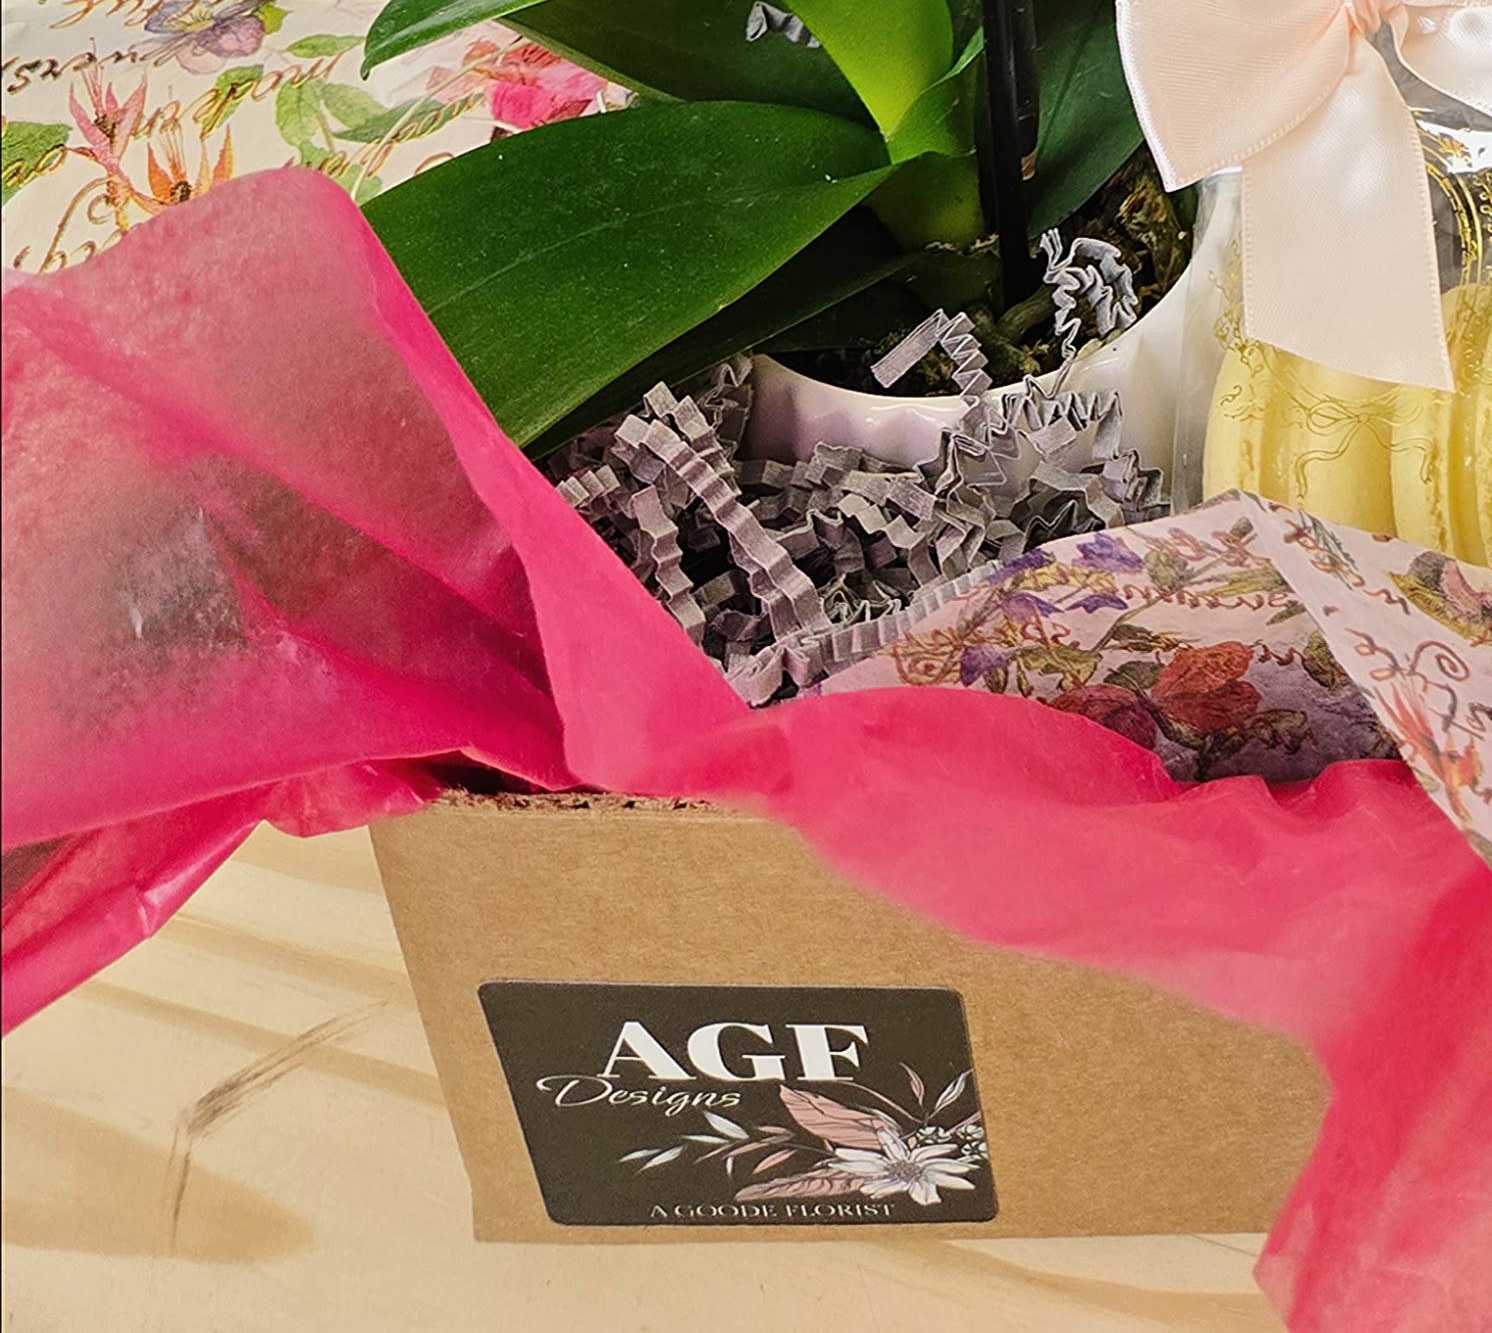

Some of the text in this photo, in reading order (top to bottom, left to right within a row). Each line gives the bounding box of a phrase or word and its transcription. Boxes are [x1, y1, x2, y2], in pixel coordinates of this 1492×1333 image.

[597, 1020, 868, 1082] AGF
[536, 1074, 741, 1117] Designs
[650, 1203, 896, 1219] A GOODE FLORIST
